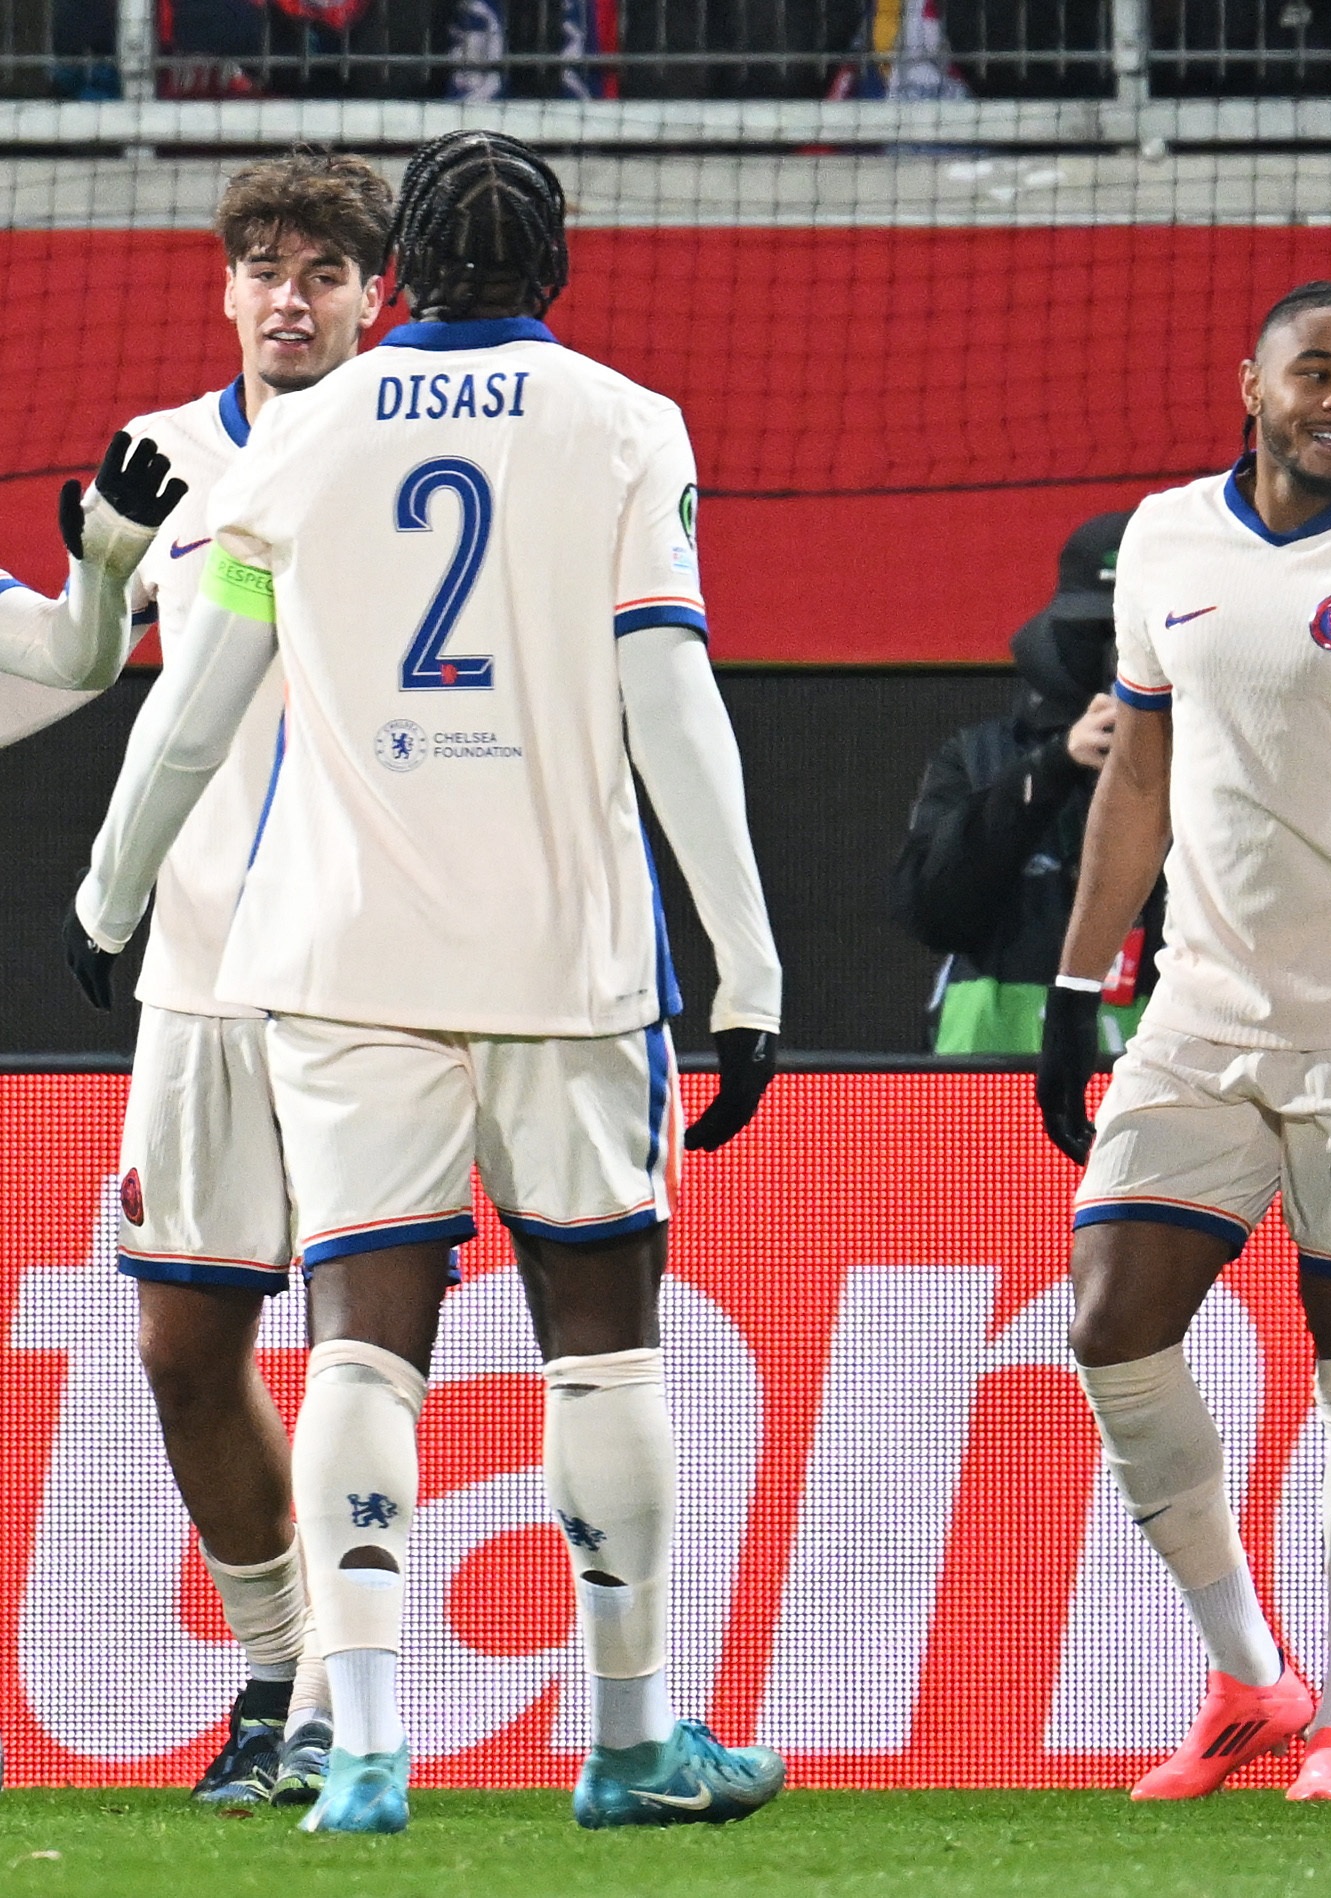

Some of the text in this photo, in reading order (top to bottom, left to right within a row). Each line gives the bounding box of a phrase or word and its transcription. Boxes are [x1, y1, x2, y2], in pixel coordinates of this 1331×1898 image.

[376, 371, 530, 421] DISASI
[393, 455, 495, 692] 2
[433, 732, 498, 744] CHELSEA
[433, 746, 523, 758] FOUNDATION
